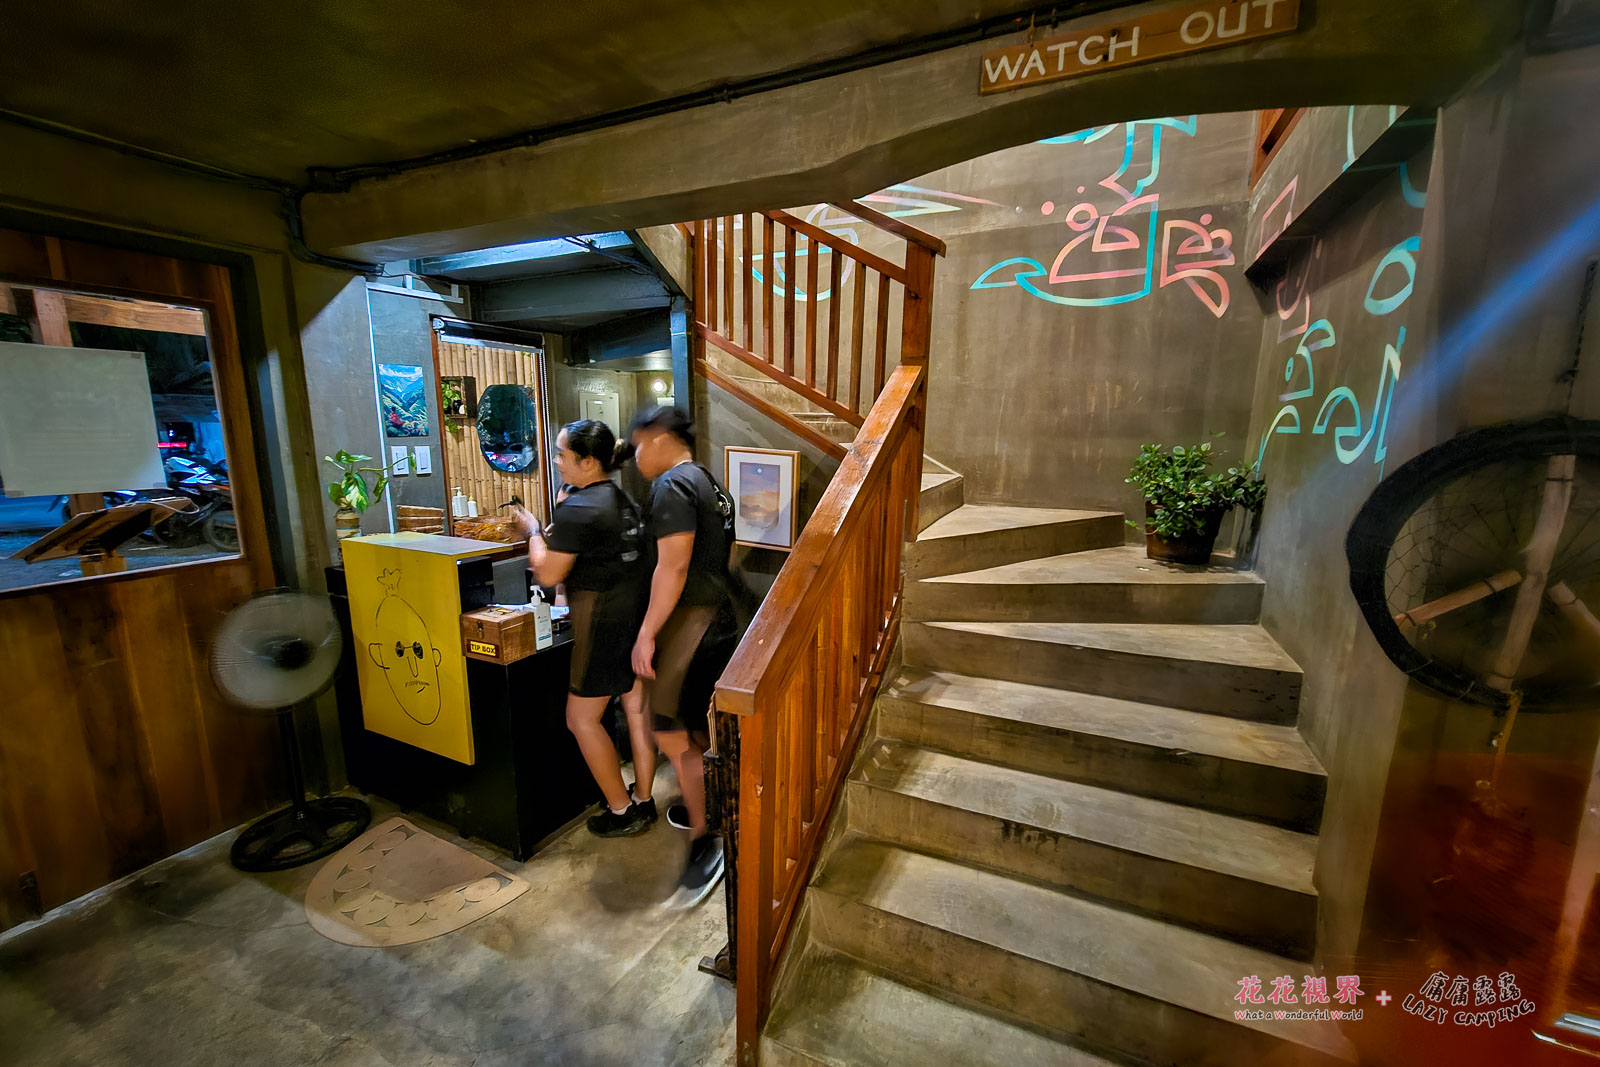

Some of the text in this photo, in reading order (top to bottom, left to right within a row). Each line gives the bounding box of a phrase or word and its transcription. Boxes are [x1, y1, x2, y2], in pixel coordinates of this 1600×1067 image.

[984, 0, 1284, 84] WATCH OUT
[470, 643, 496, 654] TIP BOX
